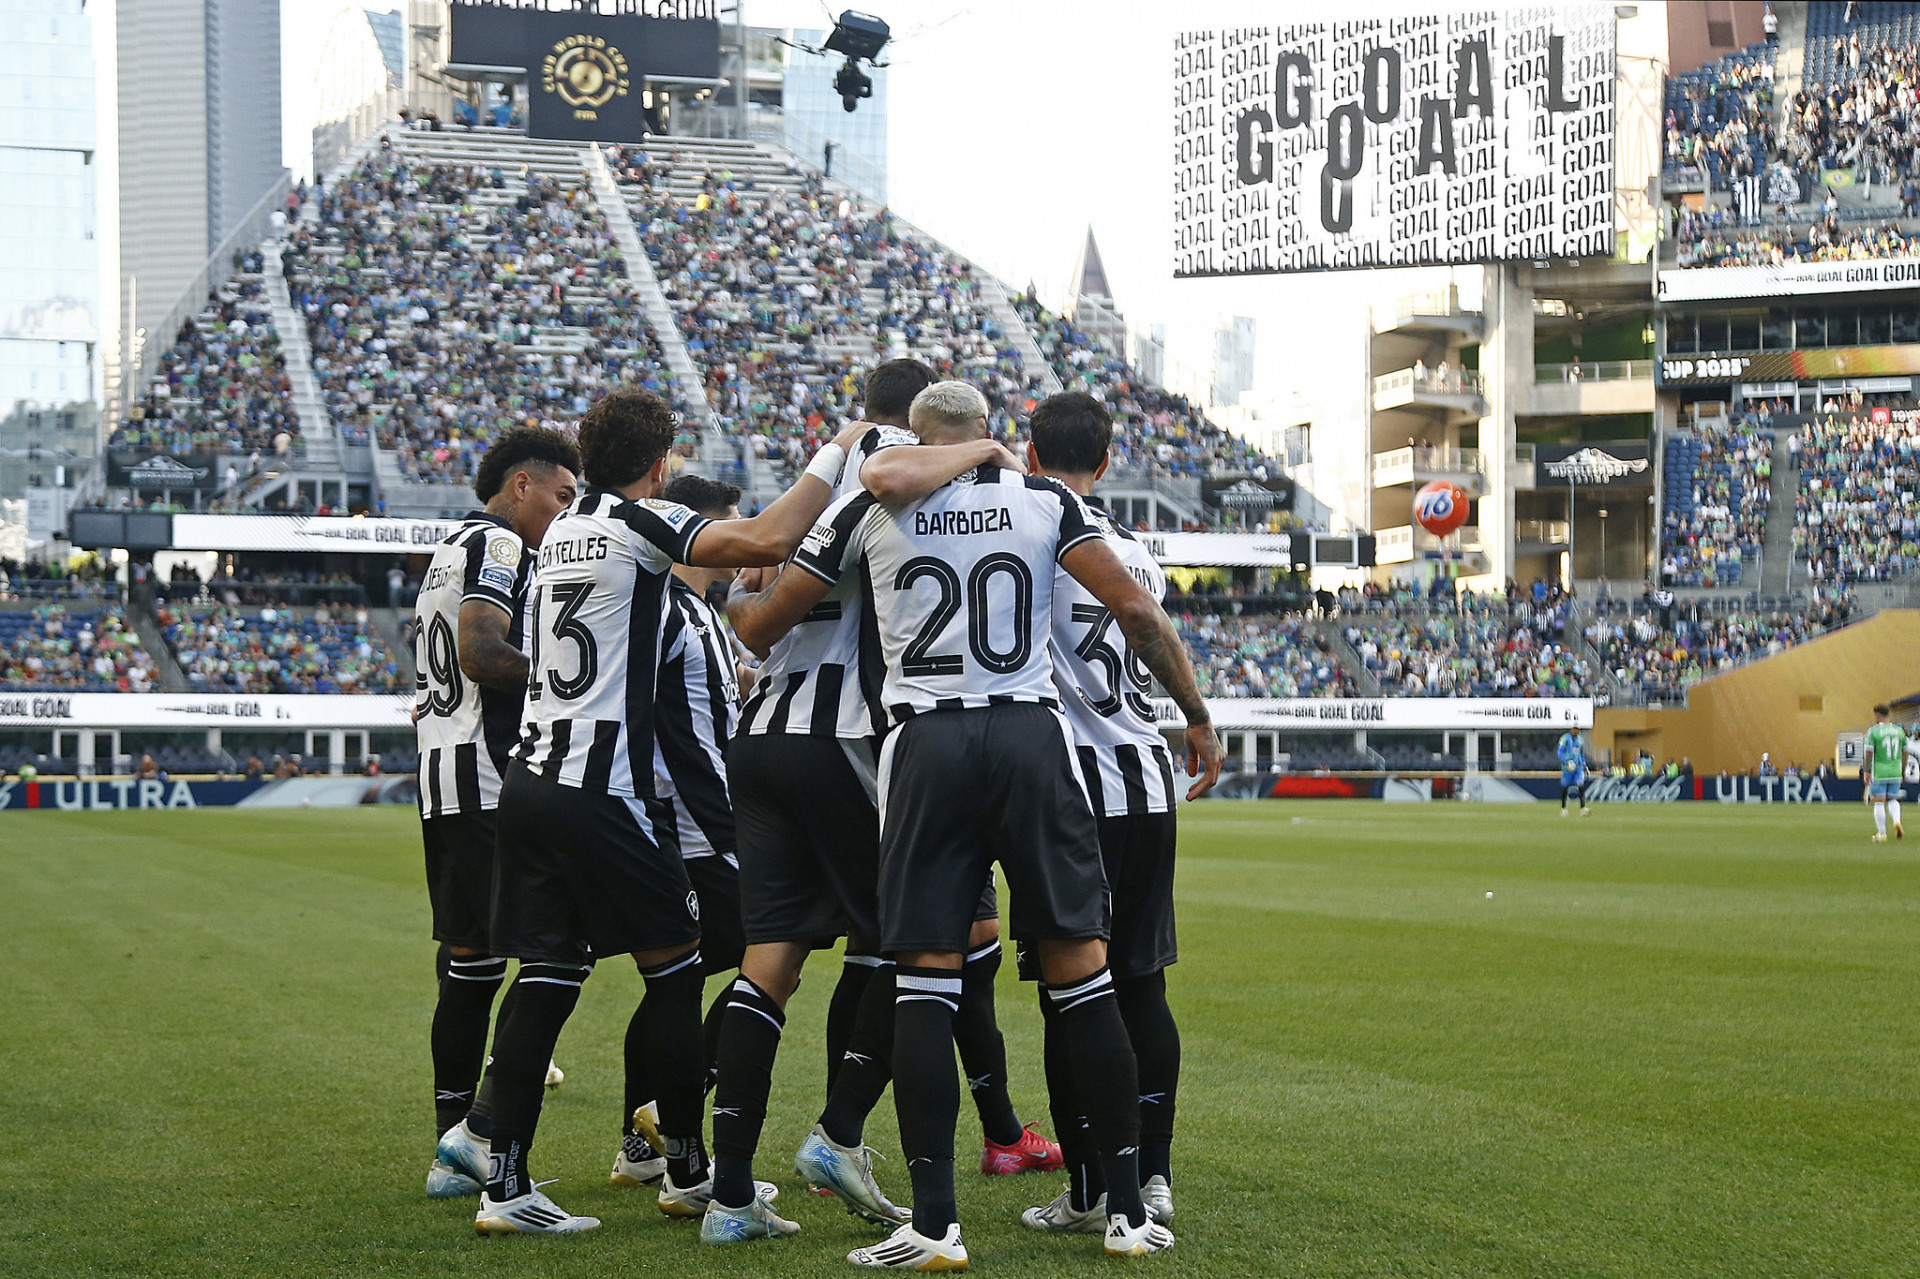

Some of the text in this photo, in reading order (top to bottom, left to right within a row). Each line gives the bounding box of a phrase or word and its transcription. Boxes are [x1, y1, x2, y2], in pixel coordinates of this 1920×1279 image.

[553, 34, 606, 53] WORLD
[1222, 42, 1270, 78] GOAL
[1222, 71, 1270, 107] GOAL
[1222, 188, 1270, 222] GOAL
[1390, 179, 1439, 214] GOAL
[1447, 175, 1497, 211] GOAL
[1505, 172, 1556, 208] GOAL
[1222, 216, 1270, 251] GOAL
[1390, 208, 1439, 243] GOAL
[1447, 204, 1497, 240] GOAL
[1505, 201, 1556, 238] GOAL
[1846, 267, 1879, 283] GOAL
[1418, 490, 1454, 519] 76
[376, 526, 405, 543] GOAL
[915, 507, 1013, 536] BARBOZA
[556, 536, 608, 565] TELLES
[894, 551, 1032, 677] 20
[529, 582, 598, 701] 13
[33, 698, 72, 718] GOAL
[1351, 702, 1385, 721] GOAL
[55, 779, 199, 811] ULTRA
[1583, 775, 1829, 805] Michelob ULTRA
